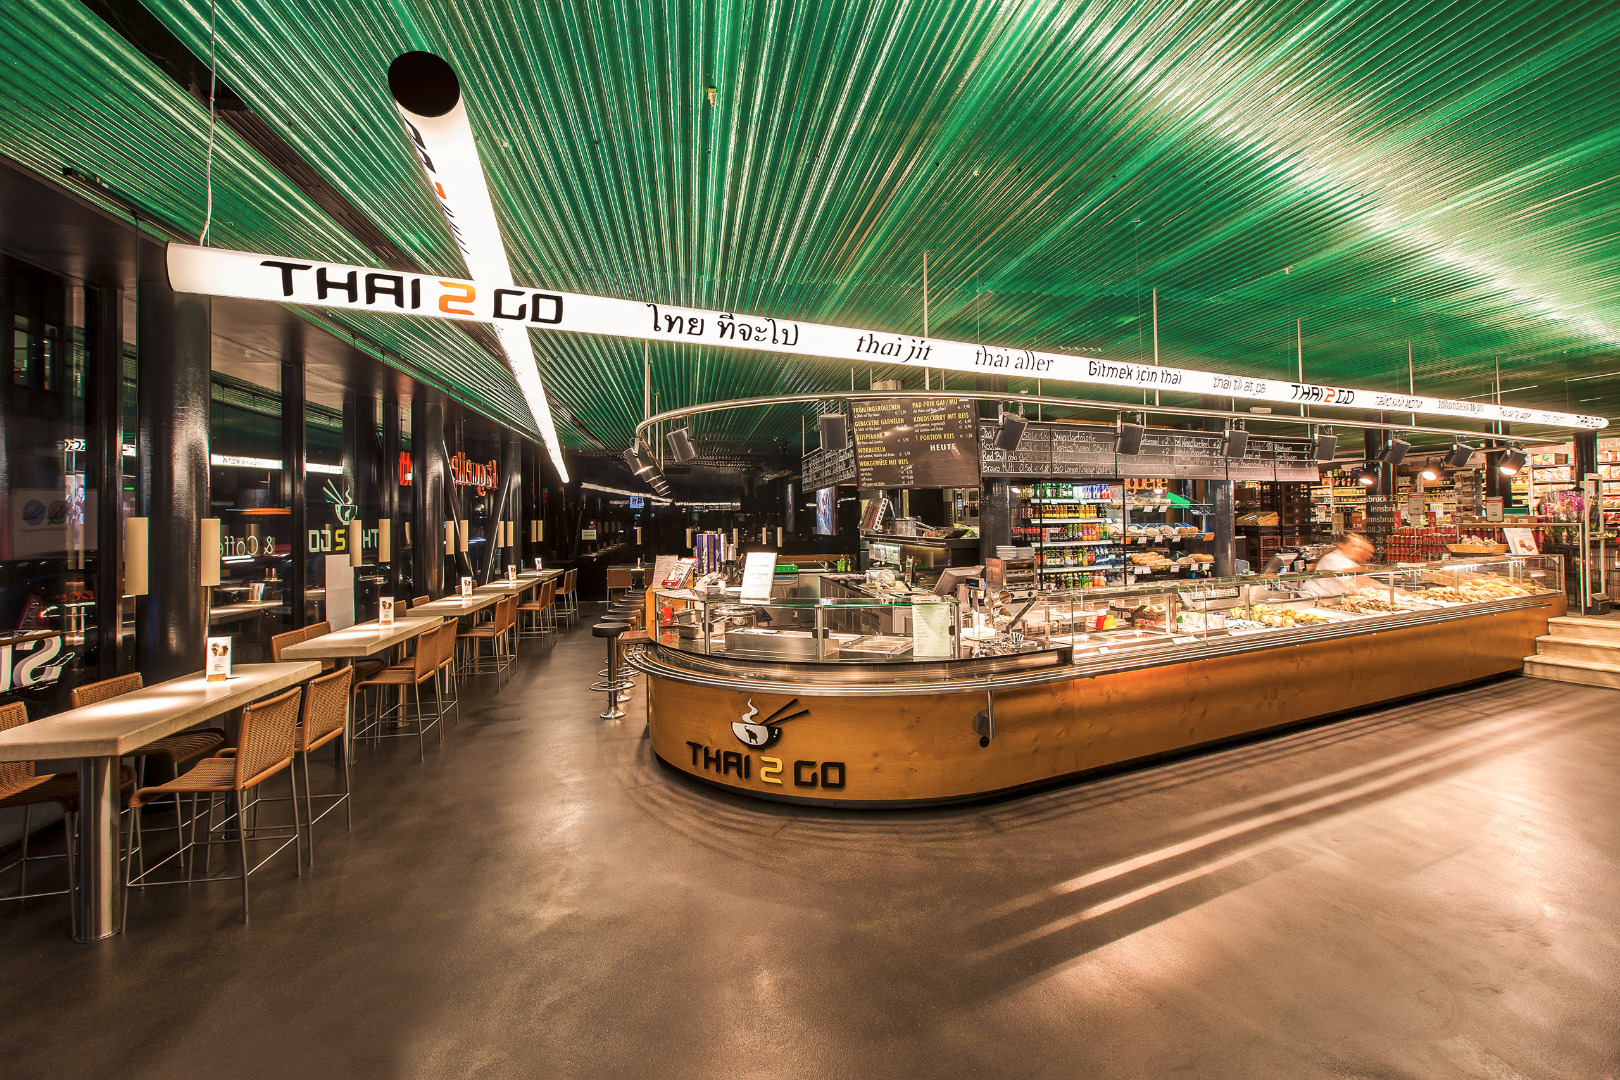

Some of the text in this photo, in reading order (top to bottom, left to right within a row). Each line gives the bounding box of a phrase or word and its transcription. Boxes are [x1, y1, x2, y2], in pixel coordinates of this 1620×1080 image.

[260, 260, 564, 325] THAI 2 GO
[646, 303, 705, 336] ไทย
[856, 333, 903, 357] thai
[975, 345, 1054, 372] thai aller
[1088, 360, 1183, 385] Gitmek için thai
[1212, 374, 1231, 390] thai
[1291, 385, 1355, 405] THAI 2 GO
[913, 414, 946, 423] KOKOSCURRY
[957, 411, 970, 419] REIS
[920, 433, 943, 441] PORTION
[930, 443, 957, 452] HEUTE
[686, 740, 847, 790] THAI 2 GO
